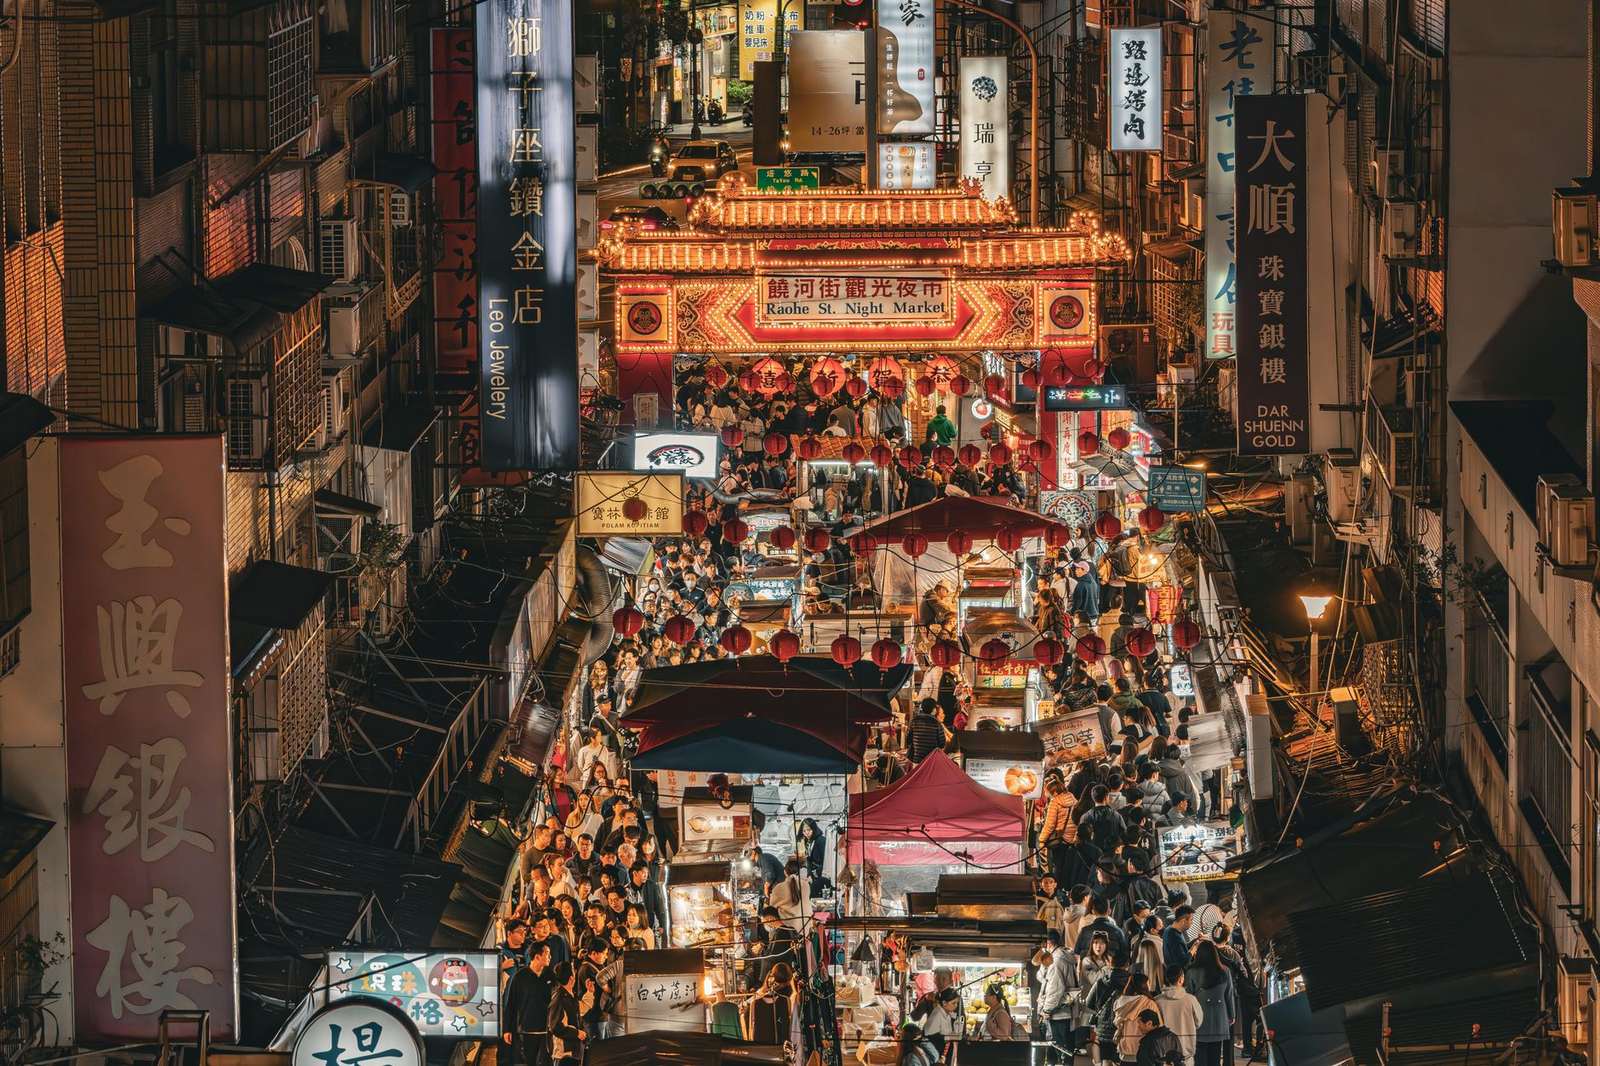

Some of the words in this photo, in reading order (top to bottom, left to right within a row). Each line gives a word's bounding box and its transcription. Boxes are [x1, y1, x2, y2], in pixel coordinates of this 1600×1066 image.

[1123, 40, 1149, 140] 路邊烤肉
[507, 16, 544, 324] 獅子座鑽金店
[767, 278, 942, 299] 饒河街觀光夜市
[488, 299, 508, 333] Leo
[766, 302, 809, 315] Raohe
[818, 302, 836, 315] St.
[846, 302, 883, 317] Night
[893, 301, 945, 314] Market
[1258, 255, 1286, 384] 珠寶銀樓
[1212, 312, 1234, 354] 玩具
[486, 340, 510, 420] Jewelery
[1244, 420, 1304, 433] SHUENN
[1257, 405, 1289, 417] DAR
[1252, 435, 1296, 447] GOLD
[81, 454, 217, 1020] 玉興銀樓
[1192, 864, 1219, 874] 200
